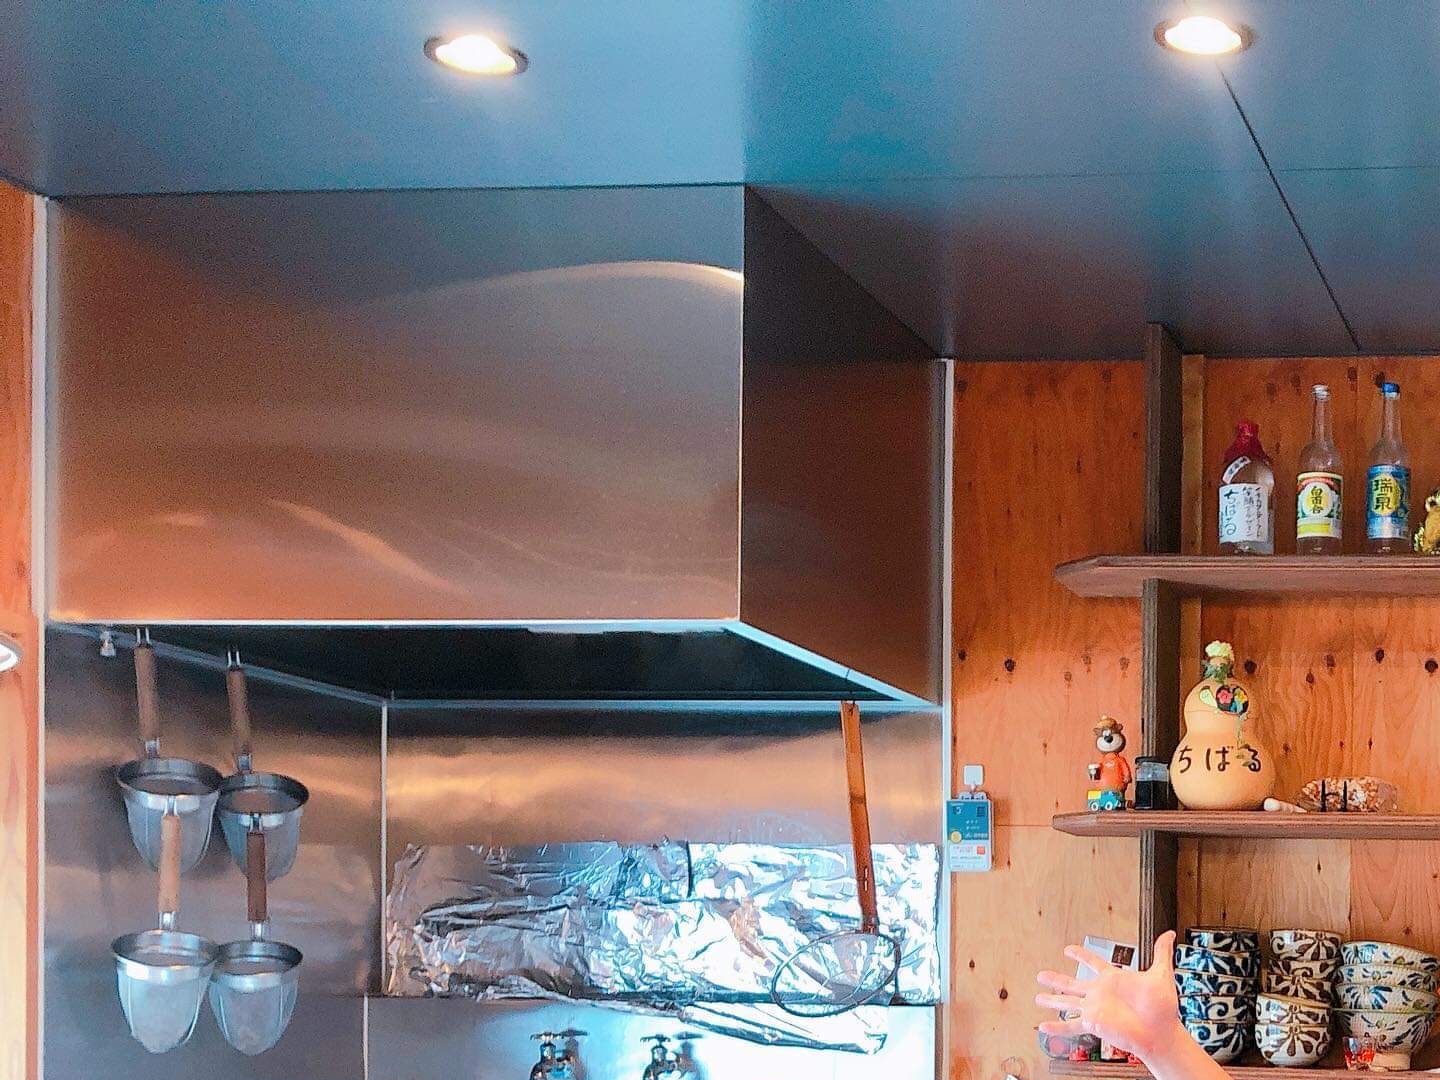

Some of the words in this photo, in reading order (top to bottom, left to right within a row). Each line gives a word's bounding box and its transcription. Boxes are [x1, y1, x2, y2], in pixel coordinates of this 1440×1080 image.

[1373, 479, 1393, 511] 瑞泉
[1178, 745, 1262, 774] ちばる
